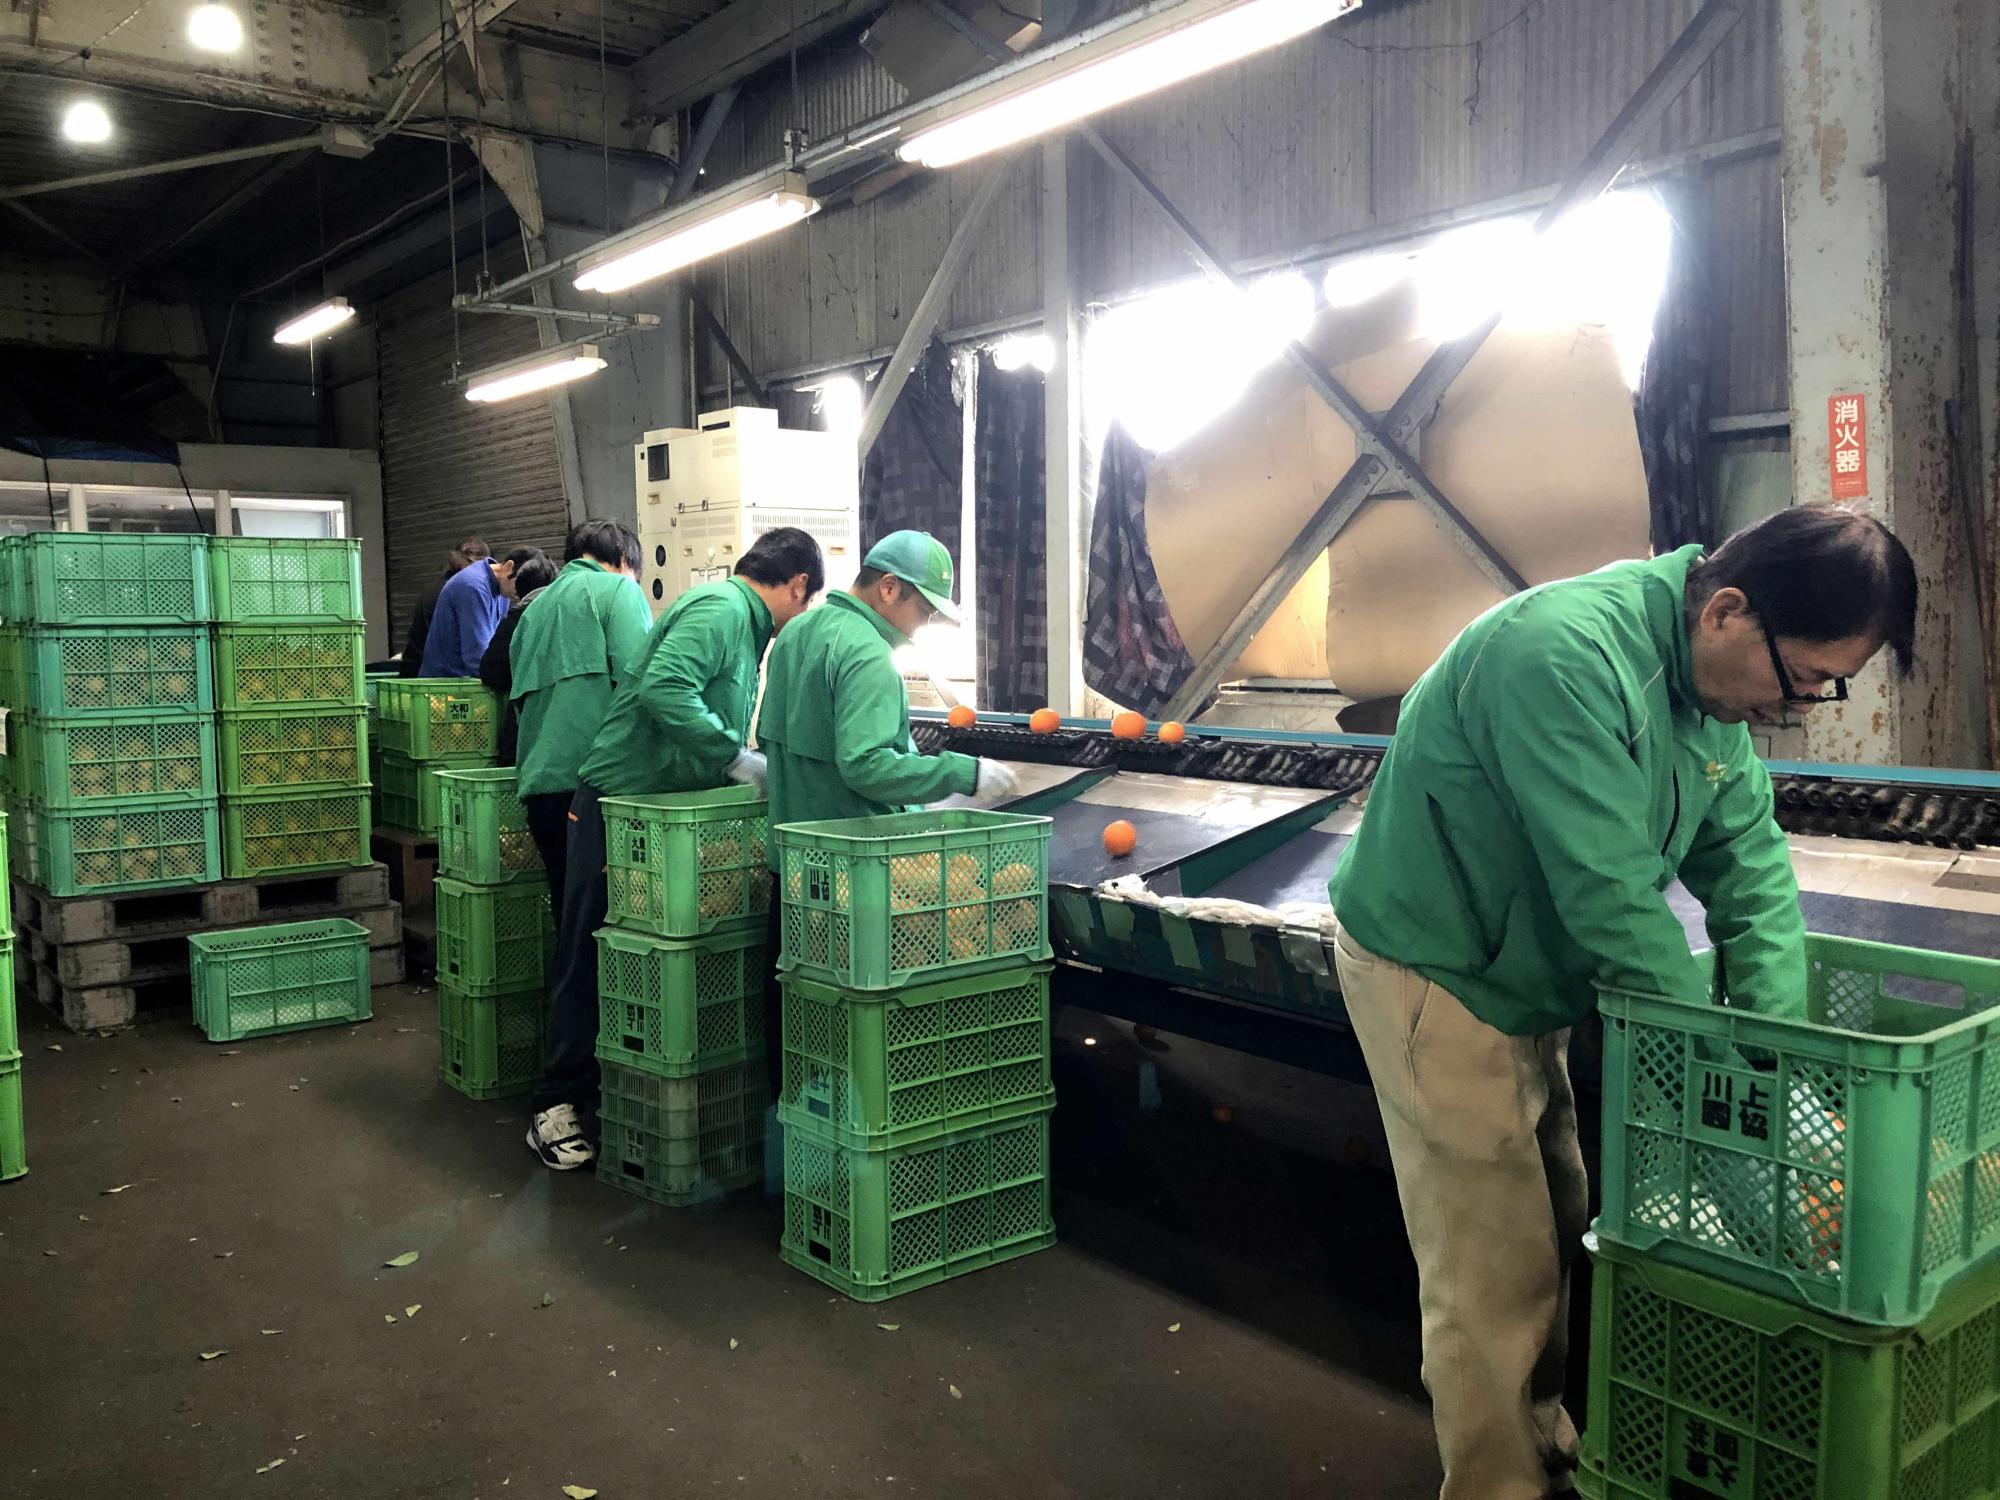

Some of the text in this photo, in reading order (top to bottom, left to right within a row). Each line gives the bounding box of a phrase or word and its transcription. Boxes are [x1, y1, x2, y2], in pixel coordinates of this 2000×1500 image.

[1834, 398, 1860, 474] 消火器
[450, 703, 469, 713] 大和
[809, 868, 829, 885] 川上
[1702, 1070, 1769, 1112] 川上
